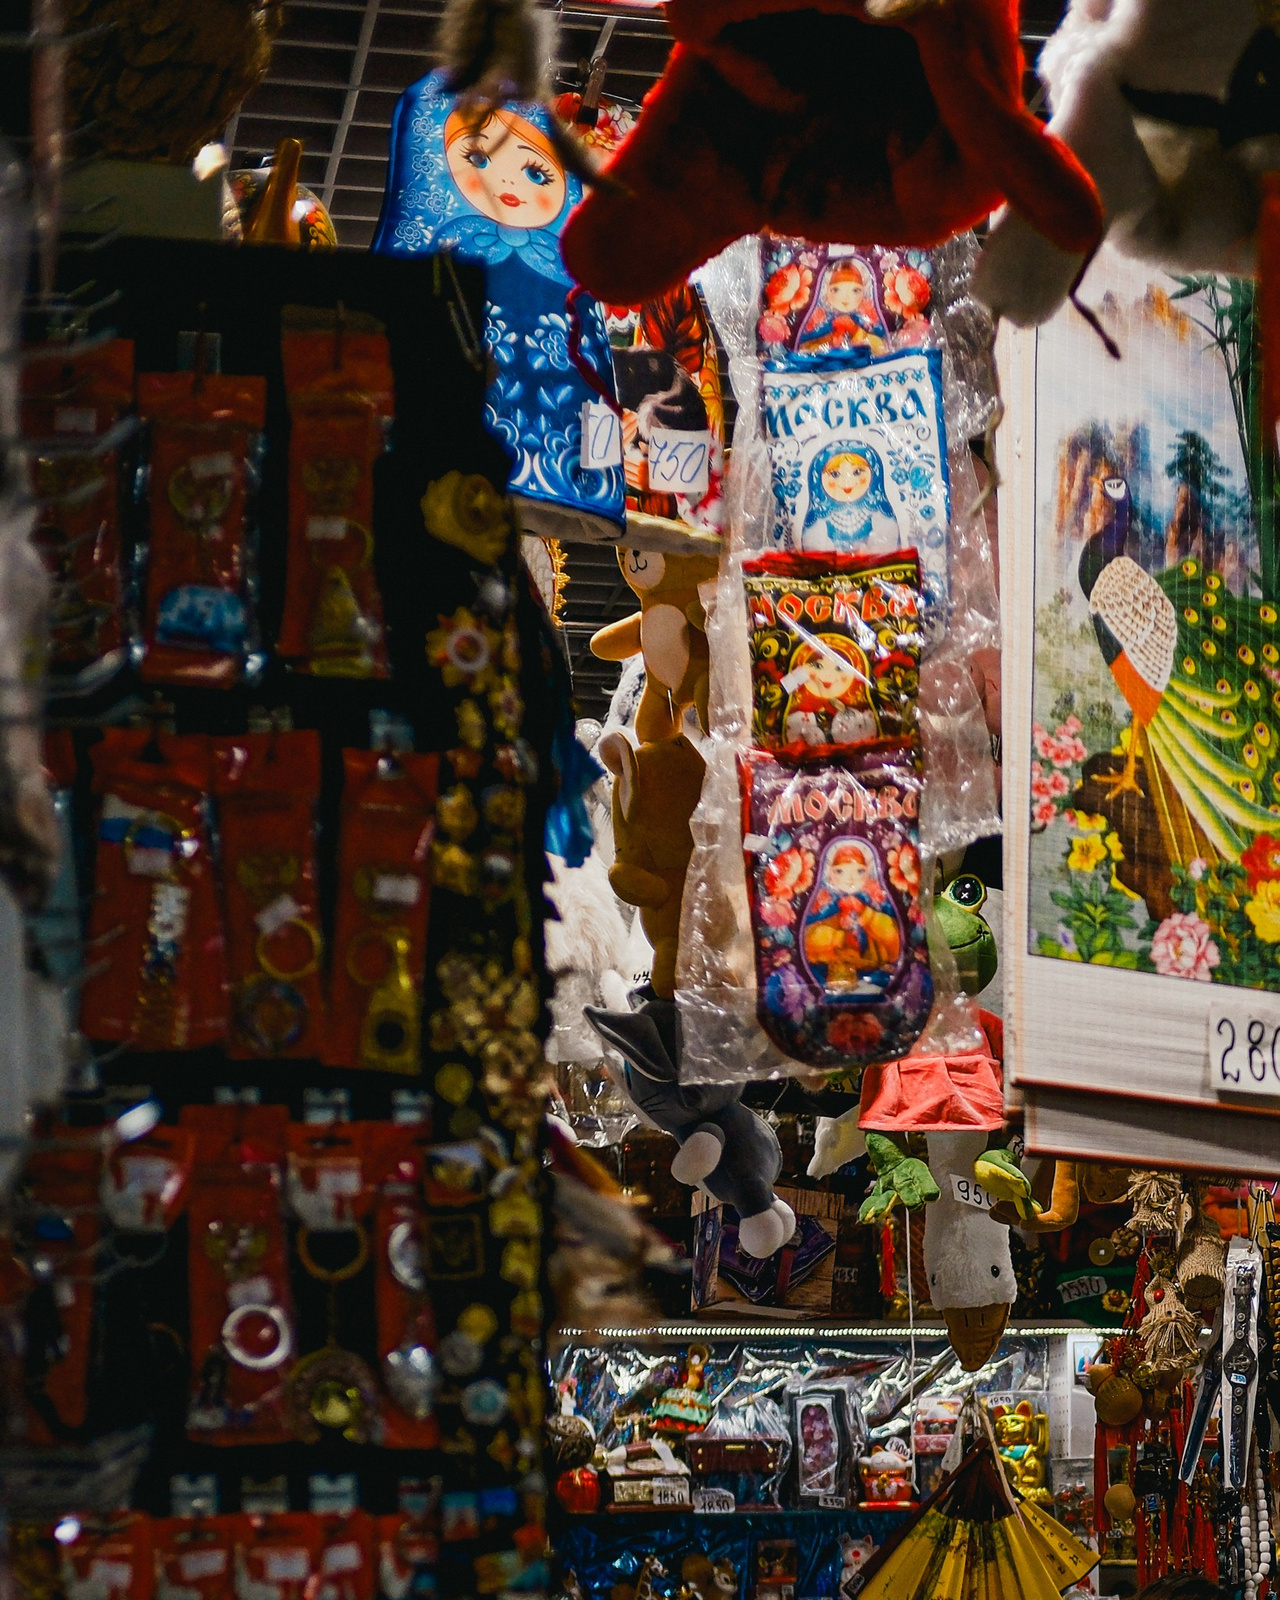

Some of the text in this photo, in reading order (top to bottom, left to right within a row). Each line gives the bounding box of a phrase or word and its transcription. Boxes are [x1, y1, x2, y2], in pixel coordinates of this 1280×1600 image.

[649, 440, 708, 484] 750
[1060, 1277, 1100, 1299] 1550
[657, 1490, 685, 1504] 1850
